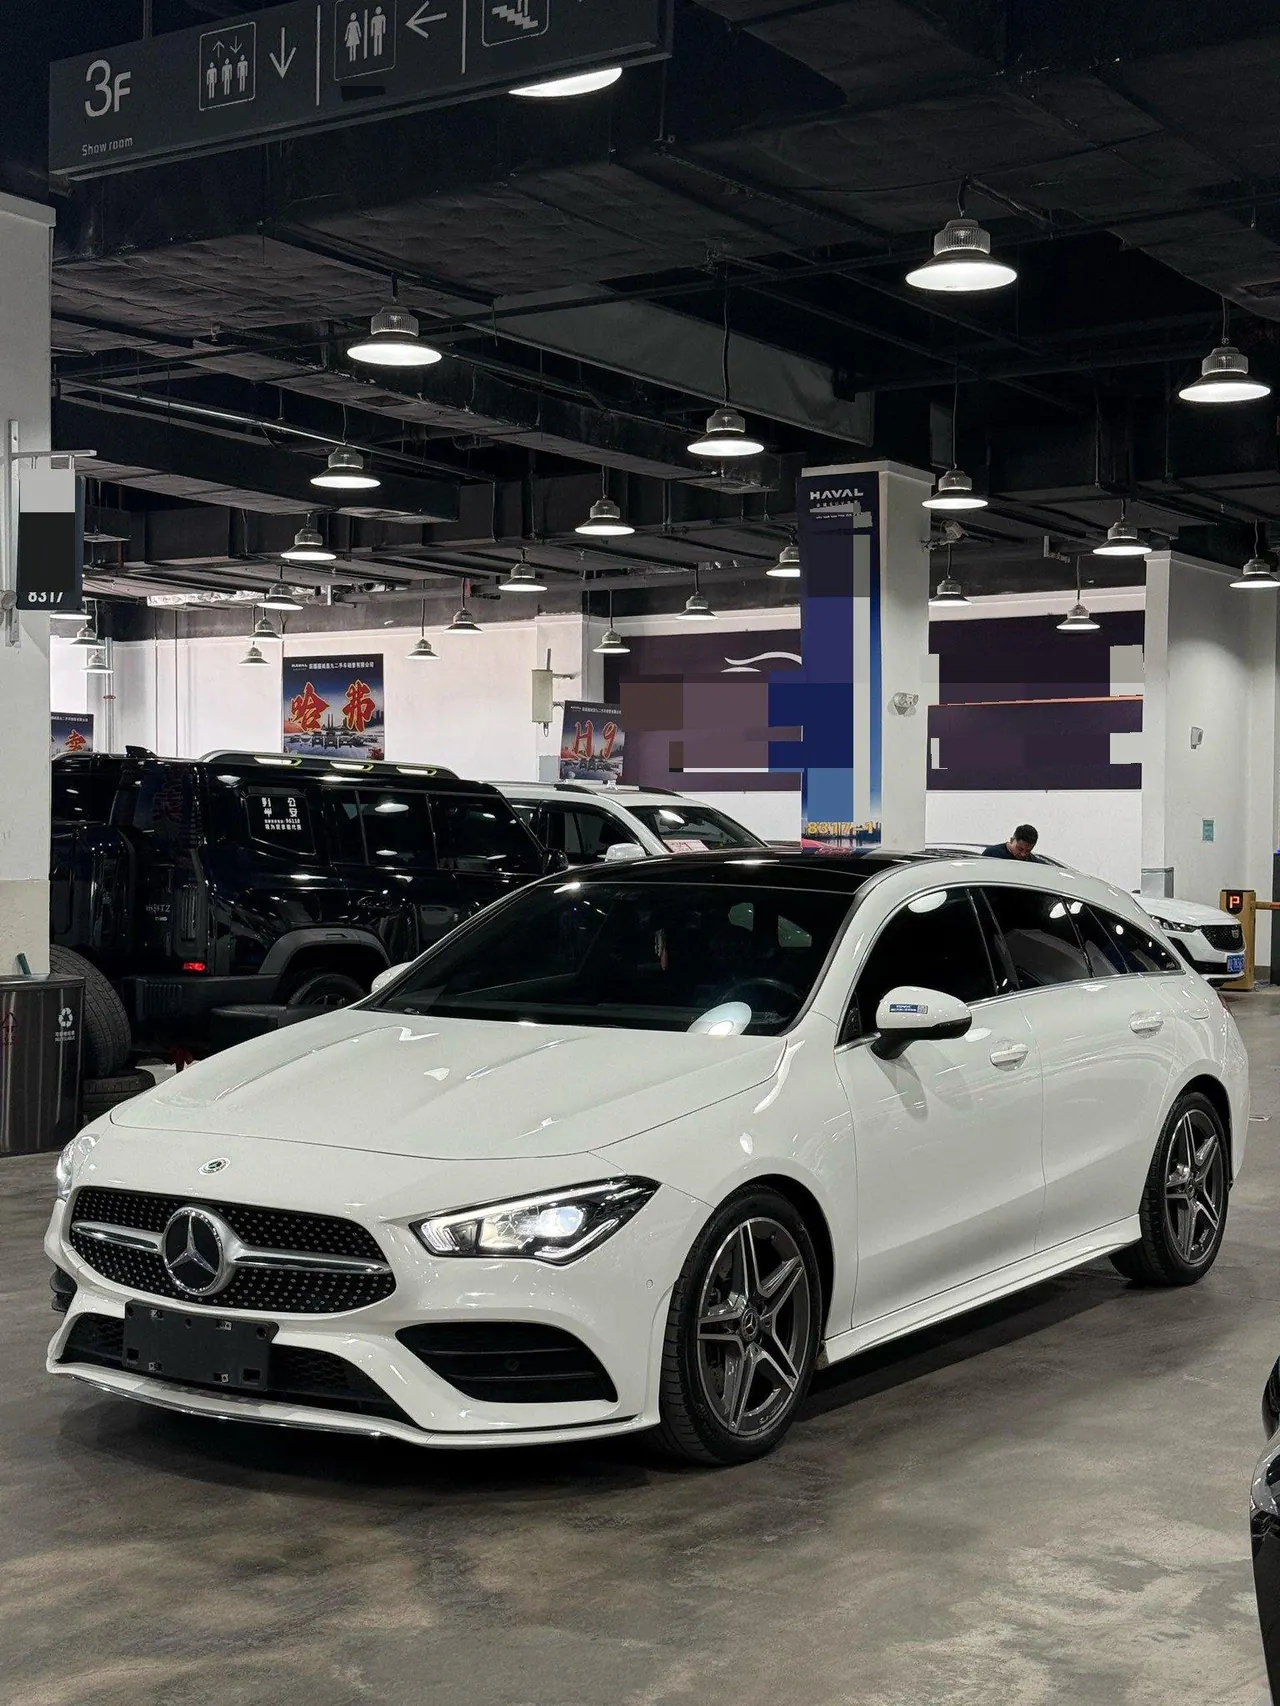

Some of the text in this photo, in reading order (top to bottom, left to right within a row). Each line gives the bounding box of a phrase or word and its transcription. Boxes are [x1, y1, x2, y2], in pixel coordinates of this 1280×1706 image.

[85, 59, 131, 117] 3F
[810, 488, 863, 500] HAVAL
[1229, 896, 1241, 909] P
